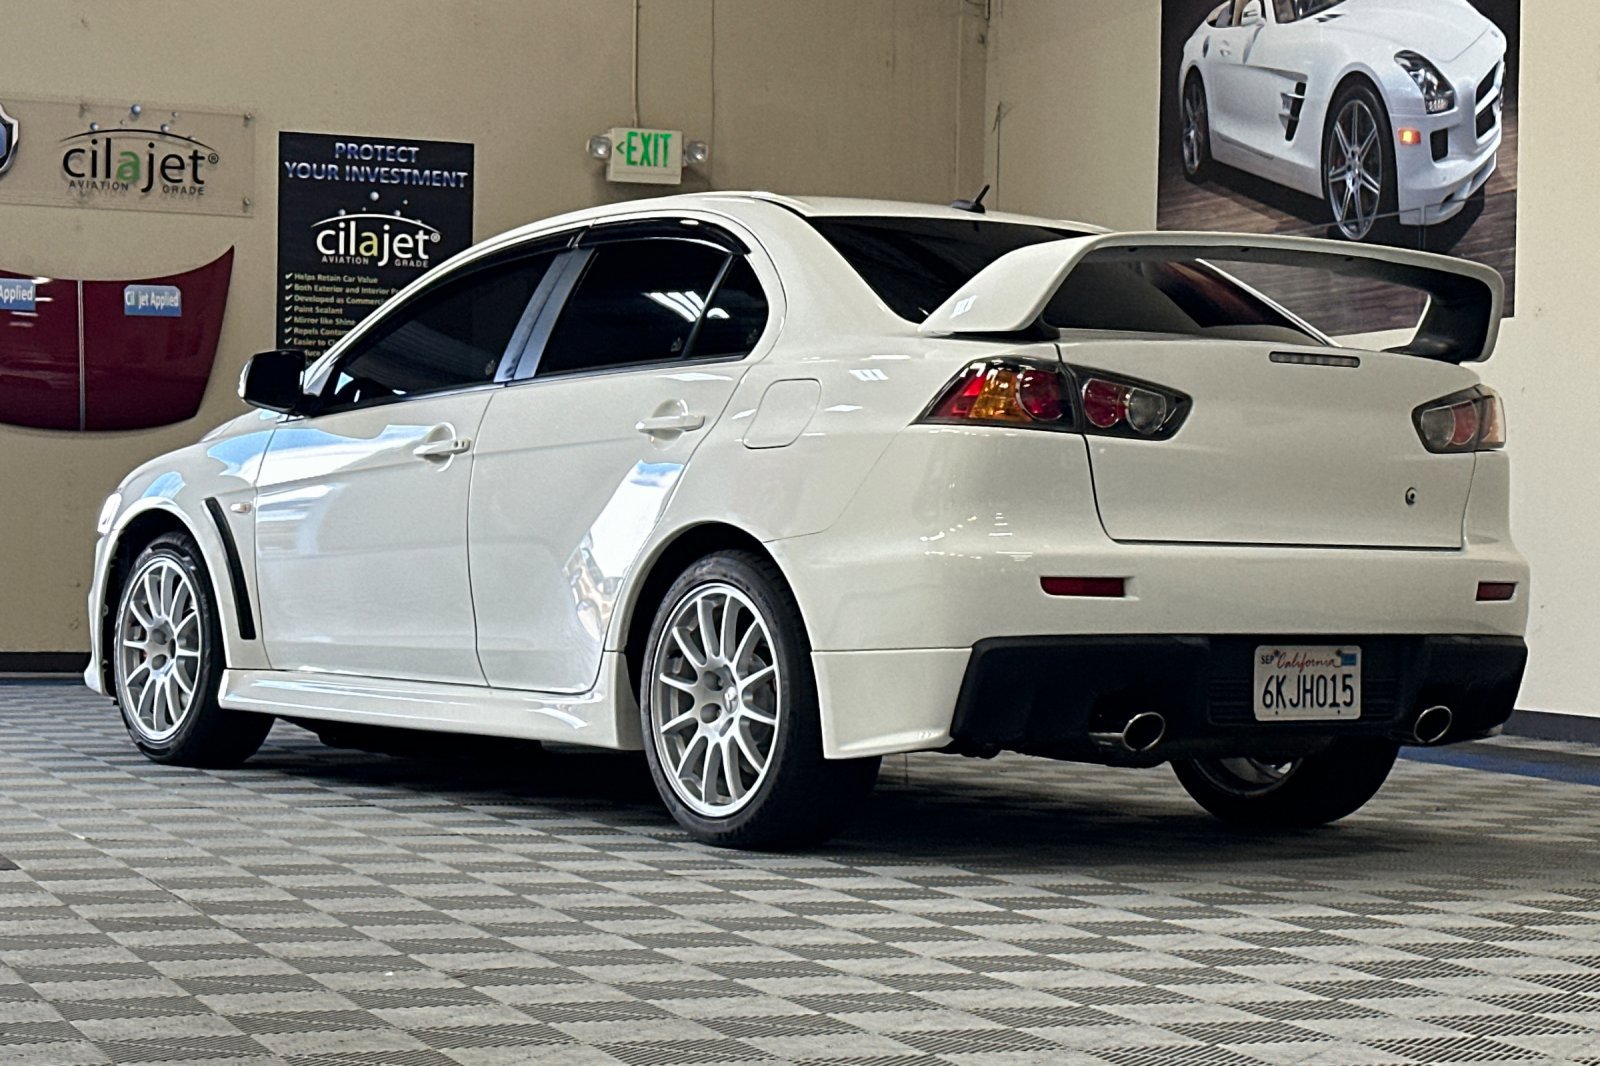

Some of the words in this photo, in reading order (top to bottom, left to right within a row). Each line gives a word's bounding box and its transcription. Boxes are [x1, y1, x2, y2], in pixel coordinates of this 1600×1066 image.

[334, 142, 420, 163] PROTECT
[626, 131, 672, 168] EXIT
[284, 161, 340, 181] YOUR
[345, 165, 469, 188] INVESTMENT
[69, 180, 129, 192] AVIATION
[162, 184, 205, 196] GRADE
[321, 255, 369, 265] AVIATION
[394, 258, 429, 268] GRADE
[294, 272, 316, 282] Helps
[317, 273, 341, 282] Retain
[342, 274, 356, 283] Car
[356, 275, 379, 284] Value
[294, 283, 313, 291] Both
[314, 284, 344, 293] Exterior
[345, 286, 360, 294] and
[361, 287, 389, 295] Interior
[150, 291, 179, 311] Applied
[294, 294, 335, 304] Developed
[317, 338, 326, 346] to
[1260, 654, 1275, 665] SEP
[1276, 652, 1342, 674] California
